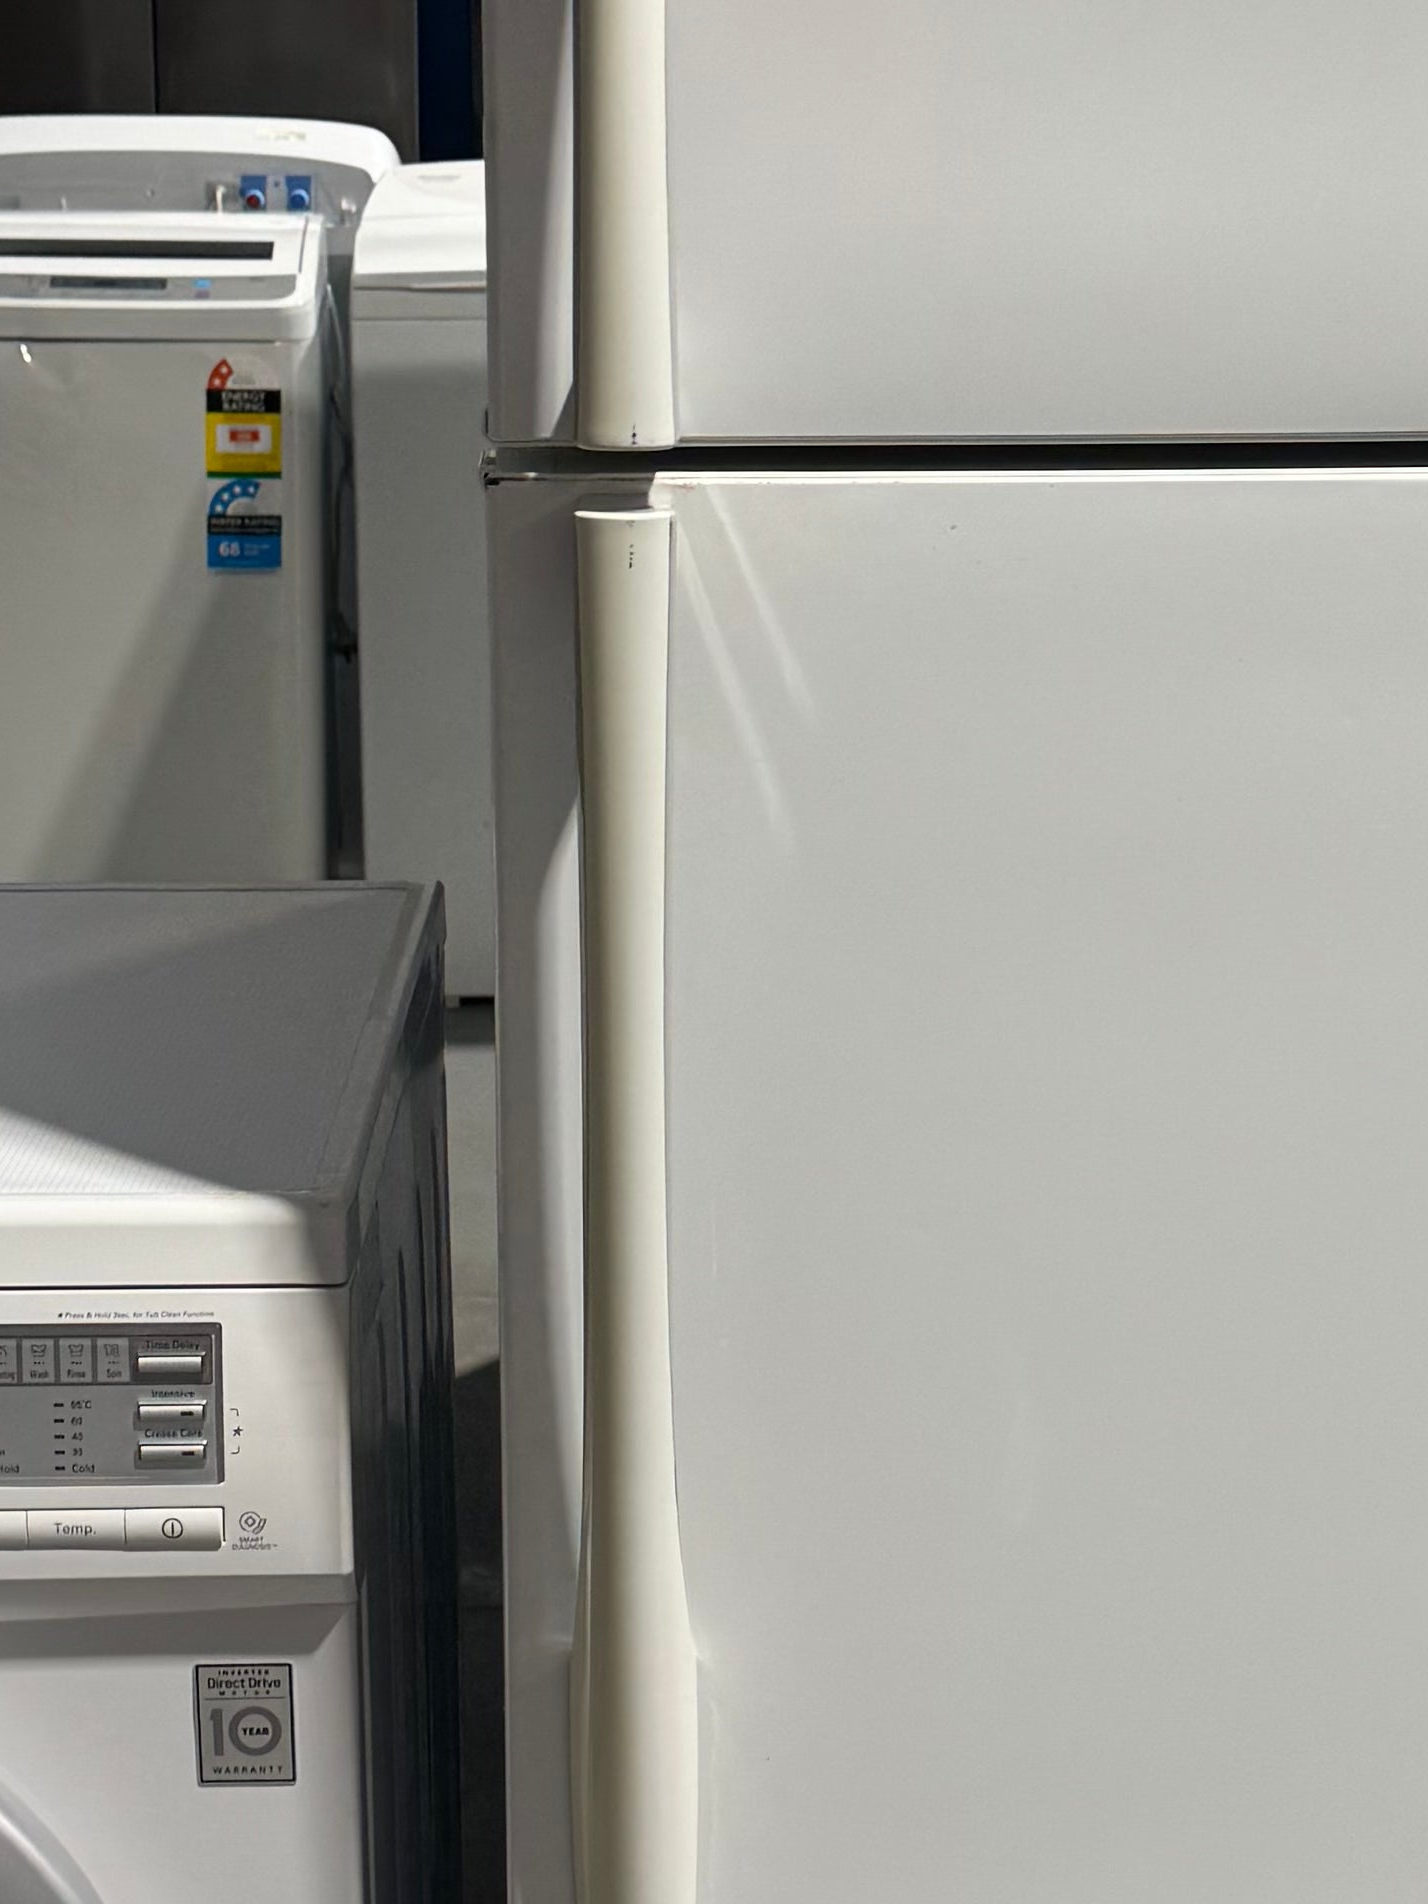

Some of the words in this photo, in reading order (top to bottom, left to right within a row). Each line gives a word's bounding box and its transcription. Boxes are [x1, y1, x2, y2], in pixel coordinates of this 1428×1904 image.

[54, 1522, 97, 1537] Temp.
[207, 1677, 245, 1689] Direct
[248, 1677, 281, 1689] Drive
[209, 1705, 282, 1757] 10
[241, 1727, 270, 1736] YEAR
[212, 1765, 284, 1775] WARRANTY
